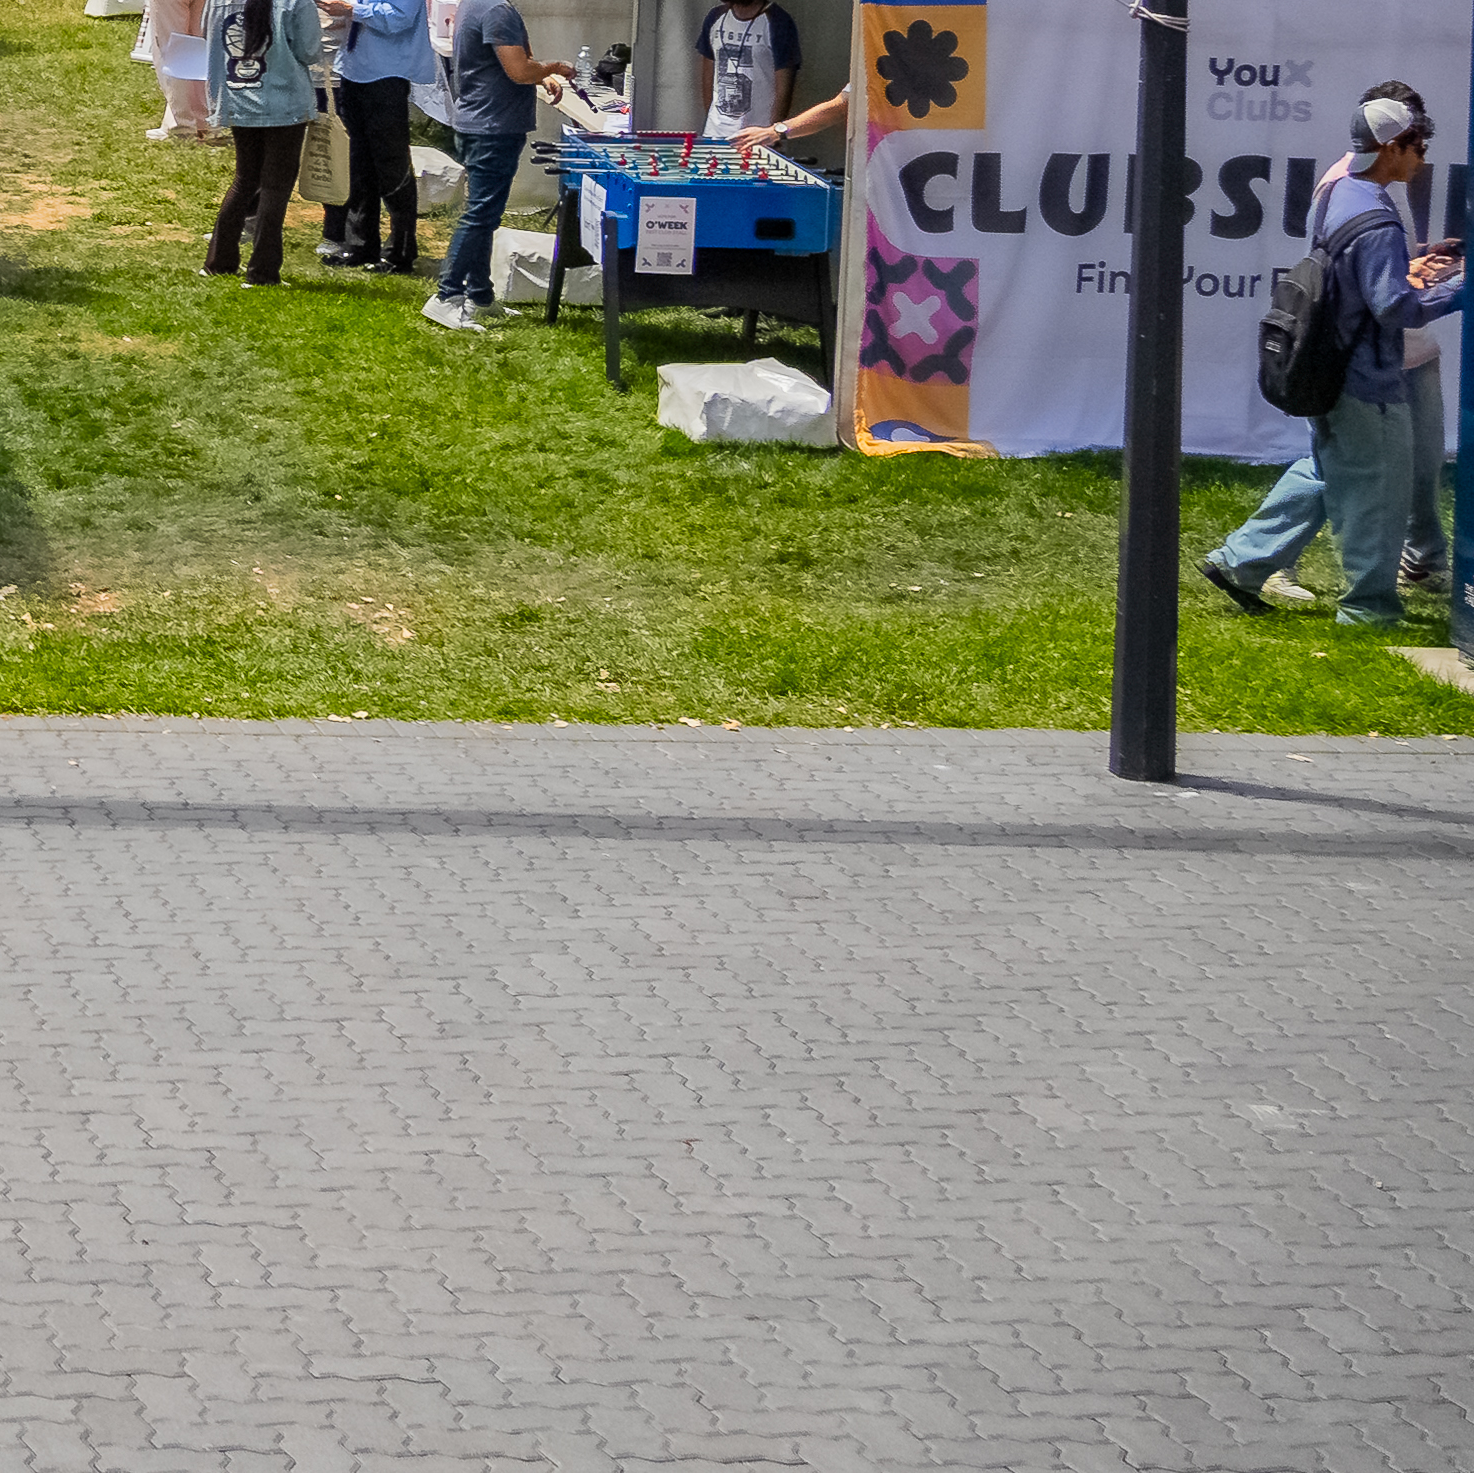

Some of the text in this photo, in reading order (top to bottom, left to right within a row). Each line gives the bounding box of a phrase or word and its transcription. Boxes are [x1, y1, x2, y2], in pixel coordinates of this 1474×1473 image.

[1208, 56, 1314, 88] YouX
[1207, 91, 1313, 123] Clubs
[645, 220, 688, 230] O'WEEK
[1075, 263, 1131, 295] Fin
[1183, 265, 1262, 299] our
